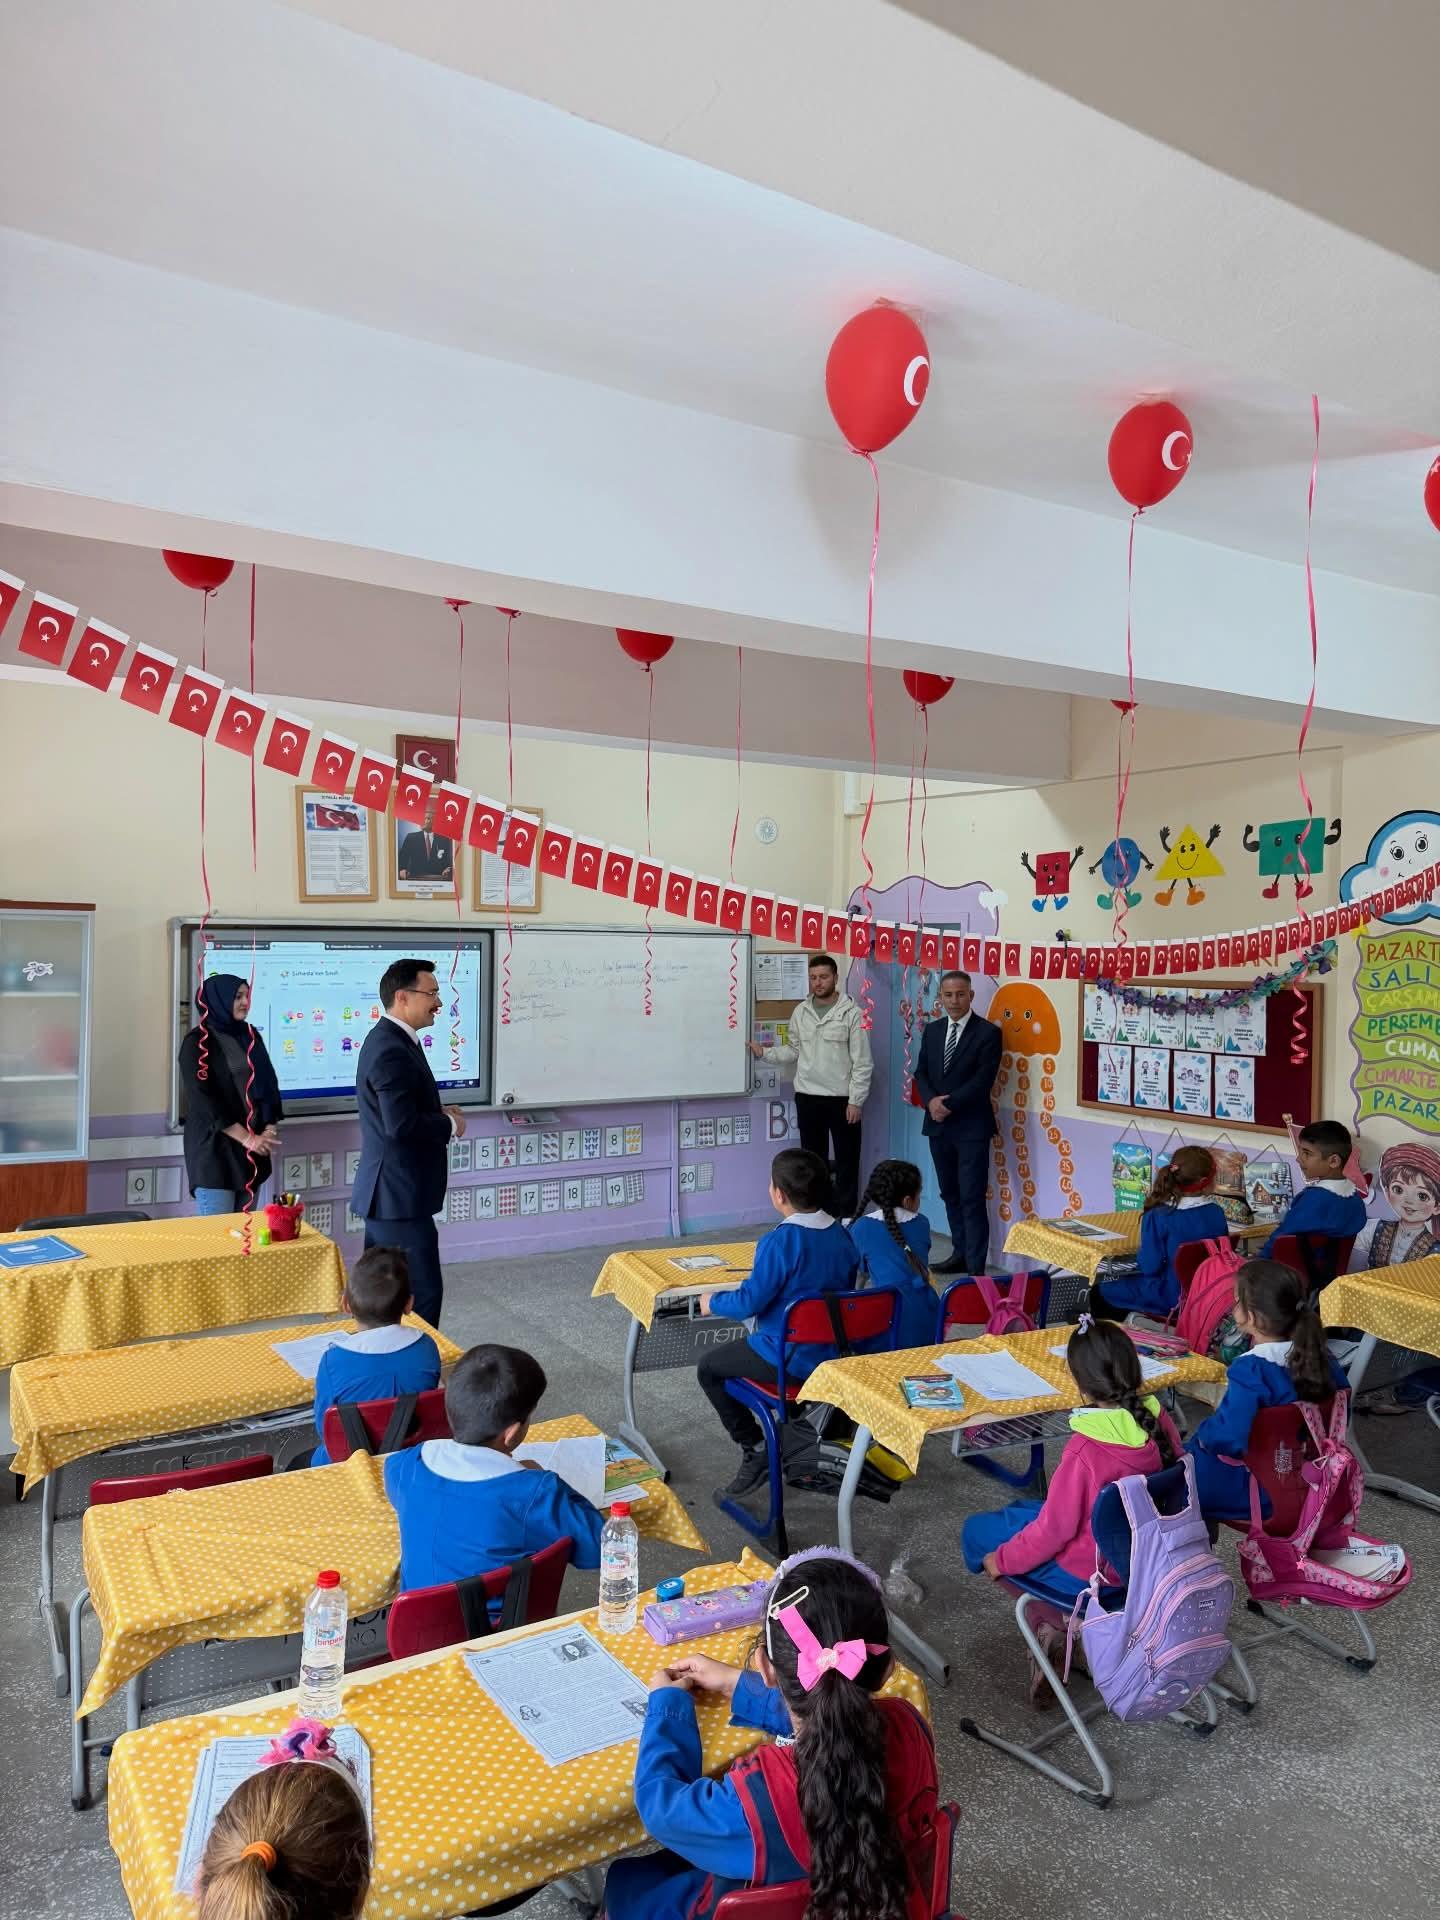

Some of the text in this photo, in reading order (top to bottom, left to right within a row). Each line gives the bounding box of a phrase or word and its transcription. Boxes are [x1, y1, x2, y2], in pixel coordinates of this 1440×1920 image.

[1367, 940, 1440, 963] PAZART
[1369, 963, 1430, 988] SALI
[1385, 1040, 1440, 1062] CUMA
[1373, 1090, 1440, 1121] PAZAR
[769, 1101, 788, 1139] B
[684, 1127, 691, 1138] 9
[720, 1123, 729, 1135] 10
[568, 1137, 575, 1150] 7
[611, 1134, 618, 1146] 8
[481, 1145, 489, 1158] 5
[525, 1142, 533, 1153] 6
[1061, 1141, 1071, 1153] 30
[291, 1164, 301, 1178] 2
[1061, 1161, 1071, 1172] 35
[680, 1171, 695, 1184] 20
[134, 1177, 145, 1192] 0
[610, 1184, 621, 1197] 19
[524, 1191, 535, 1204] 17
[568, 1187, 578, 1199] 18
[480, 1195, 492, 1209] 16
